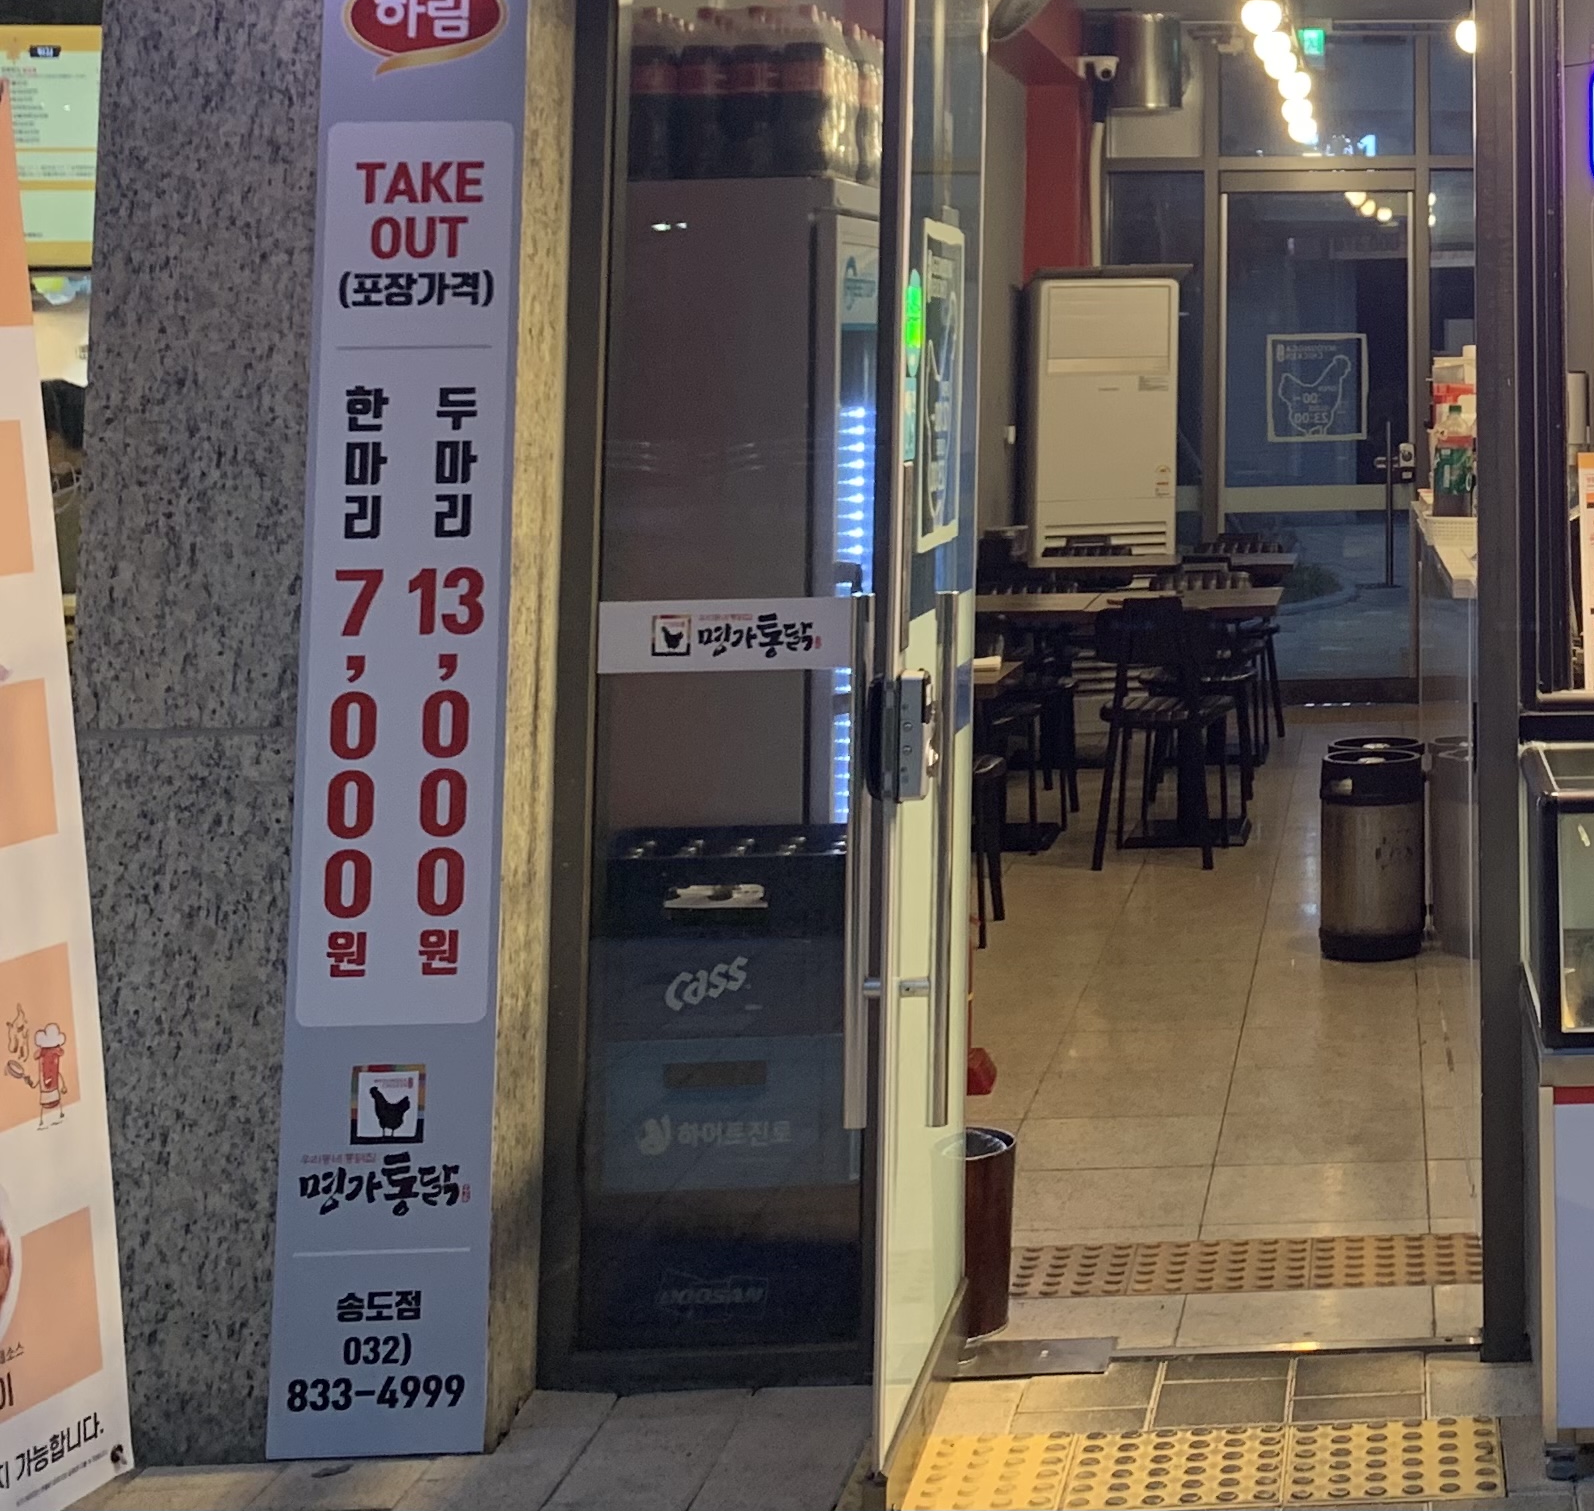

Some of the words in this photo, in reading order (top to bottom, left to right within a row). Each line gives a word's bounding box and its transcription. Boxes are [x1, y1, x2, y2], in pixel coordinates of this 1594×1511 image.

[356, 161, 485, 204] TAKE
[371, 216, 468, 259] OUT
[339, 270, 495, 310] (포장가격)
[344, 384, 390, 540] 한마리
[433, 386, 478, 539] 두마리
[698, 613, 813, 658] 명가통닭
[299, 1151, 460, 1217] 명가통닭
[336, 1290, 422, 1323] 송도점
[343, 1333, 412, 1367] 032)
[286, 1374, 466, 1412] 833-4999
[16, 1411, 105, 1481] 가능합니다.
